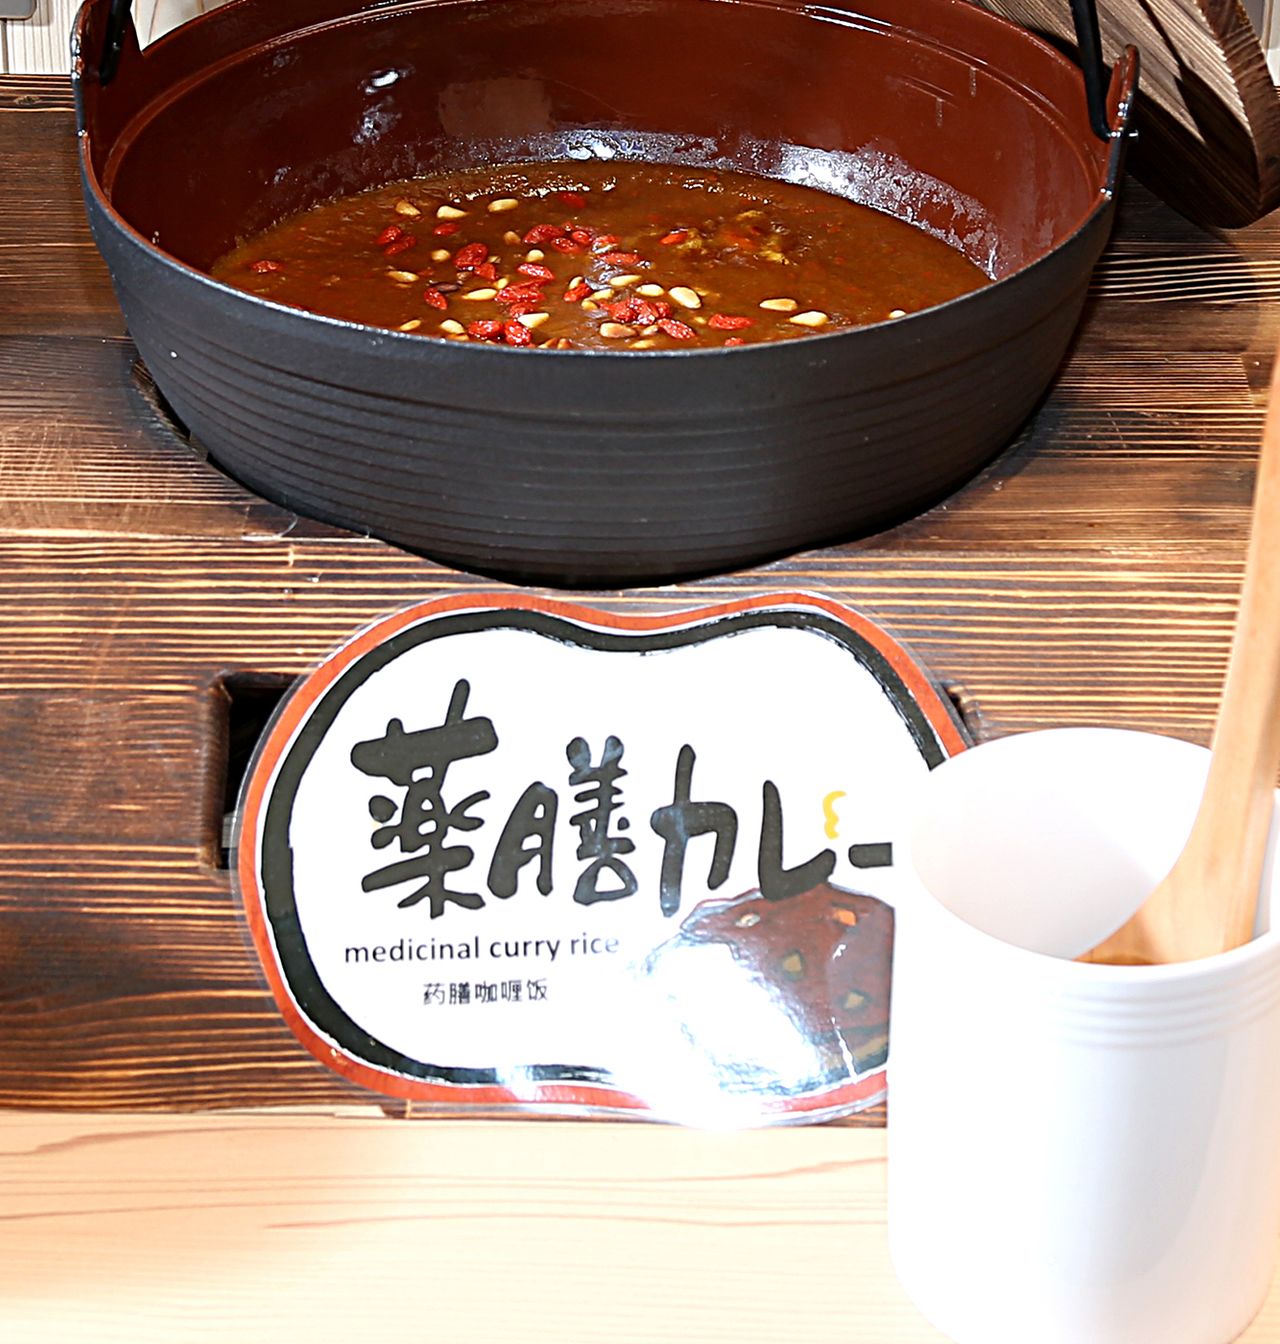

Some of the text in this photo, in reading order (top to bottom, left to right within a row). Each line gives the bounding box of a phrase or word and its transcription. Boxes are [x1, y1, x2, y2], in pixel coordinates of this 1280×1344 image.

[345, 932, 619, 963] medicinal curry rice
[423, 978, 548, 1006] 药膳咖喱饭
